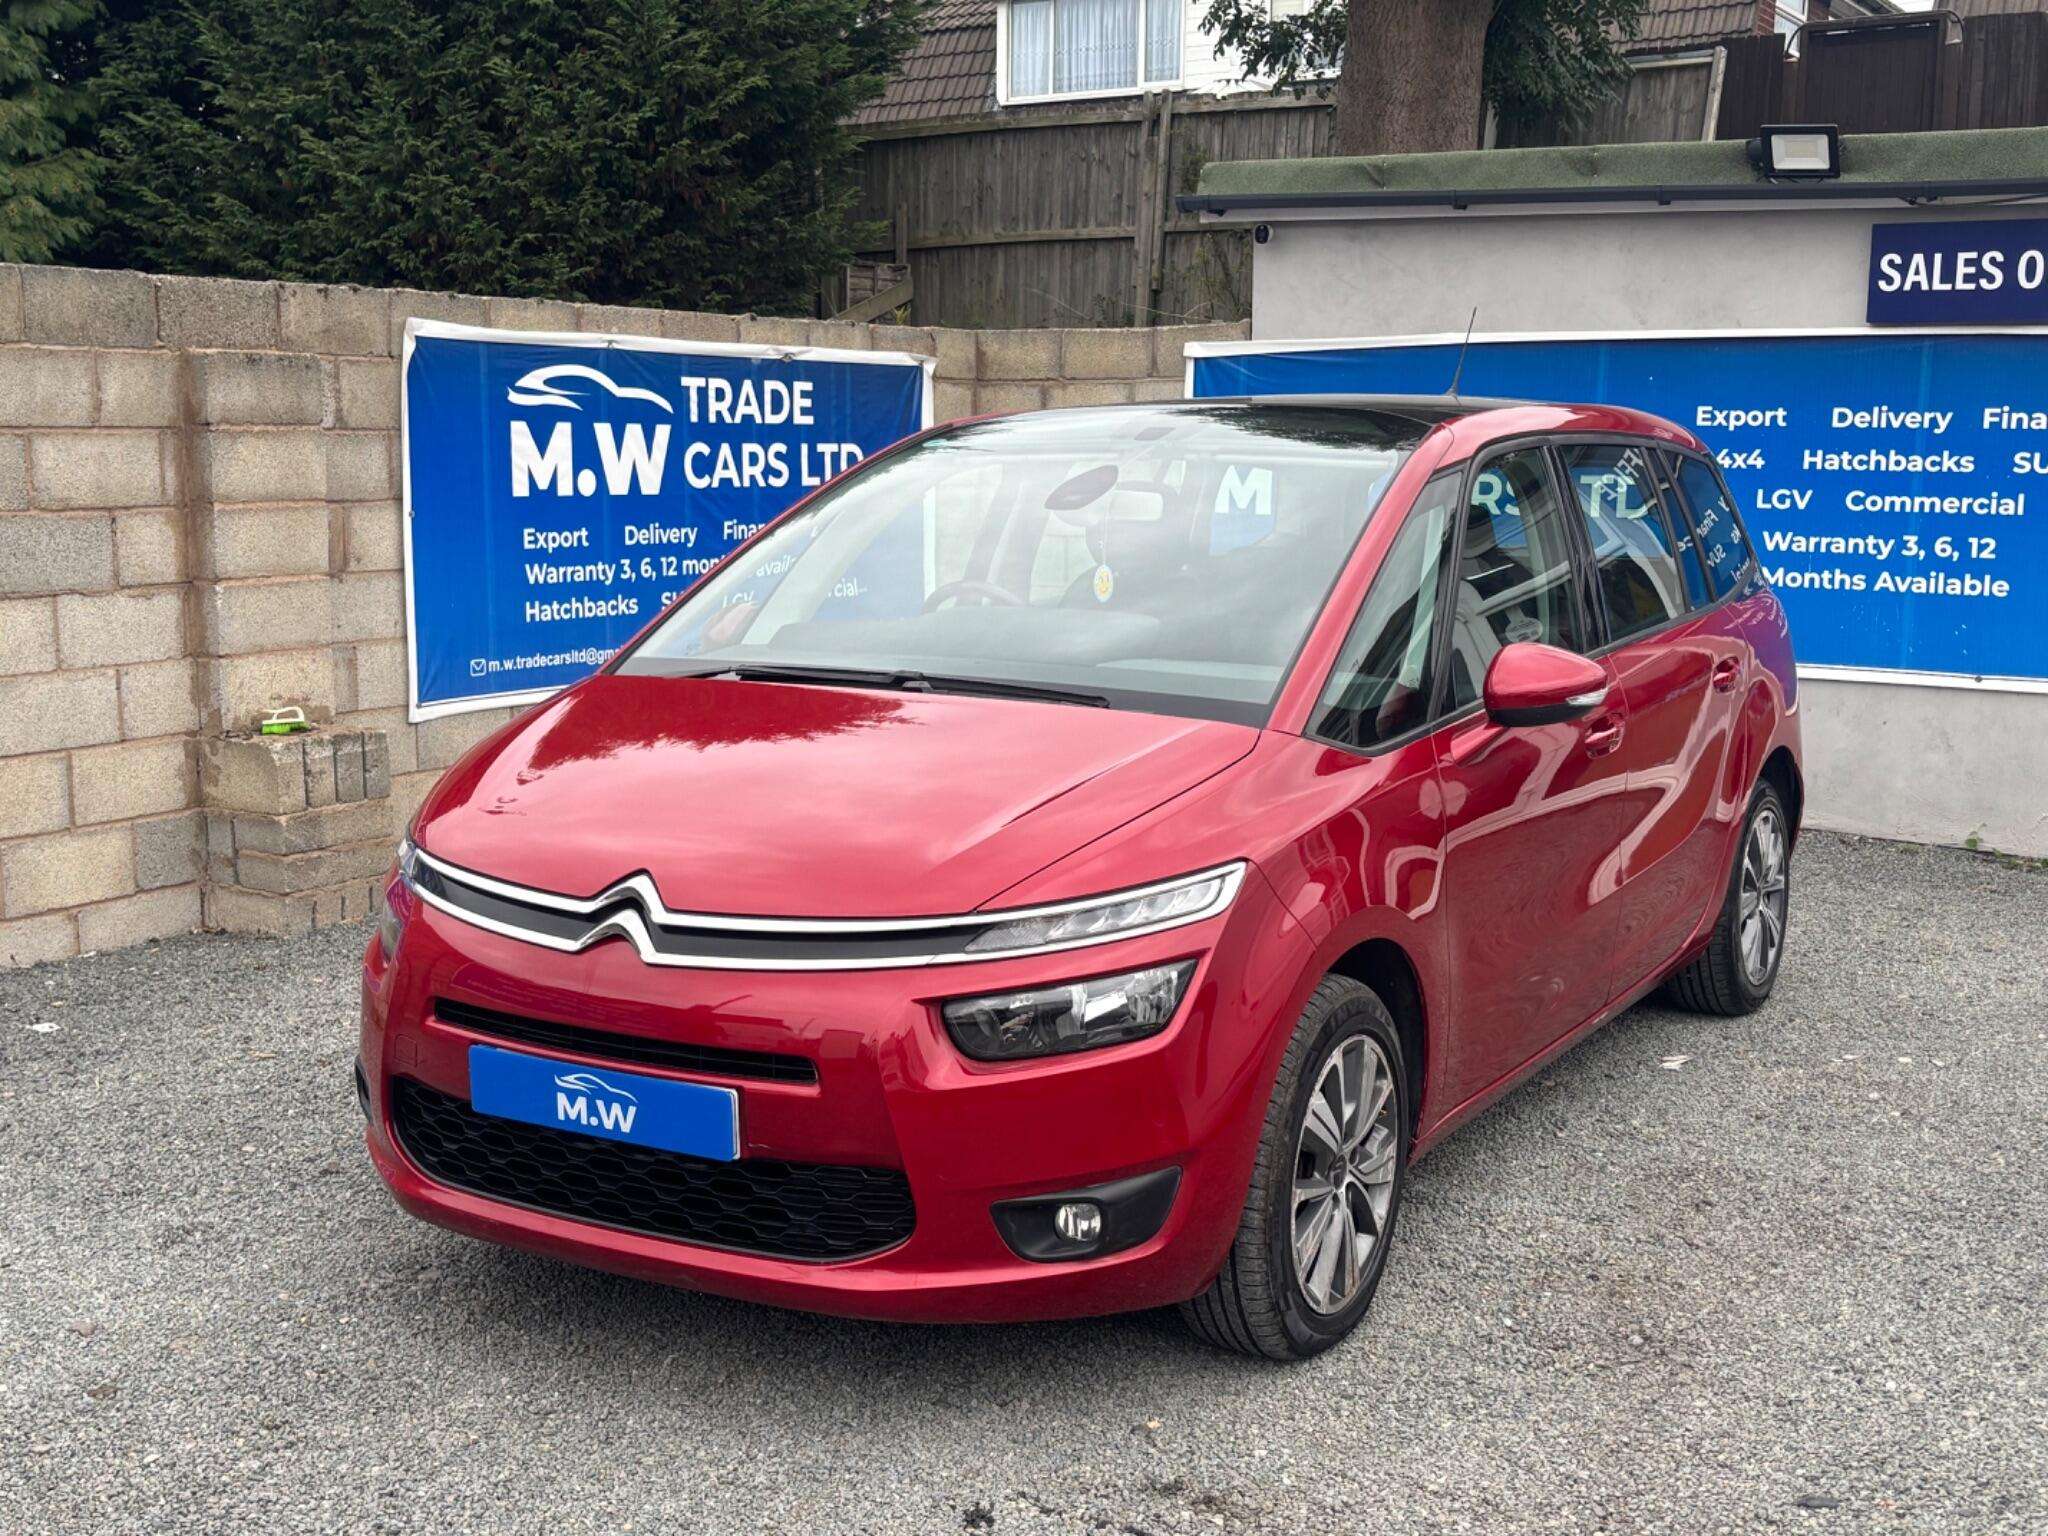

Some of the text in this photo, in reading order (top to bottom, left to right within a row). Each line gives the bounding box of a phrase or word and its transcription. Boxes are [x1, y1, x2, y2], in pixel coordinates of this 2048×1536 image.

[1877, 250, 2005, 292] SALES
[680, 376, 815, 425] TRADE
[1696, 406, 1788, 431] Export
[1831, 405, 1954, 434] Delivery
[510, 420, 672, 498] M.W
[683, 441, 864, 489] CARS LTD
[1716, 448, 1766, 470] 4x4
[1802, 448, 1975, 473] Hatchbacks
[1756, 488, 1813, 510] LGV
[1845, 490, 2025, 516] Commercial
[523, 527, 589, 554] Export
[624, 522, 698, 548] Delivery
[1762, 531, 1896, 561] Warranty
[1901, 534, 1926, 561] 3,
[1934, 536, 1960, 562] 6,
[1968, 537, 1996, 559] 12
[524, 563, 616, 588] Warranty
[620, 558, 636, 582] 3,
[640, 557, 657, 581] 6,
[660, 556, 678, 577] 12
[1763, 566, 1867, 592] Months
[1873, 570, 2010, 598] Available
[525, 594, 639, 623] Hatchbacks
[556, 1090, 637, 1133] M.W
